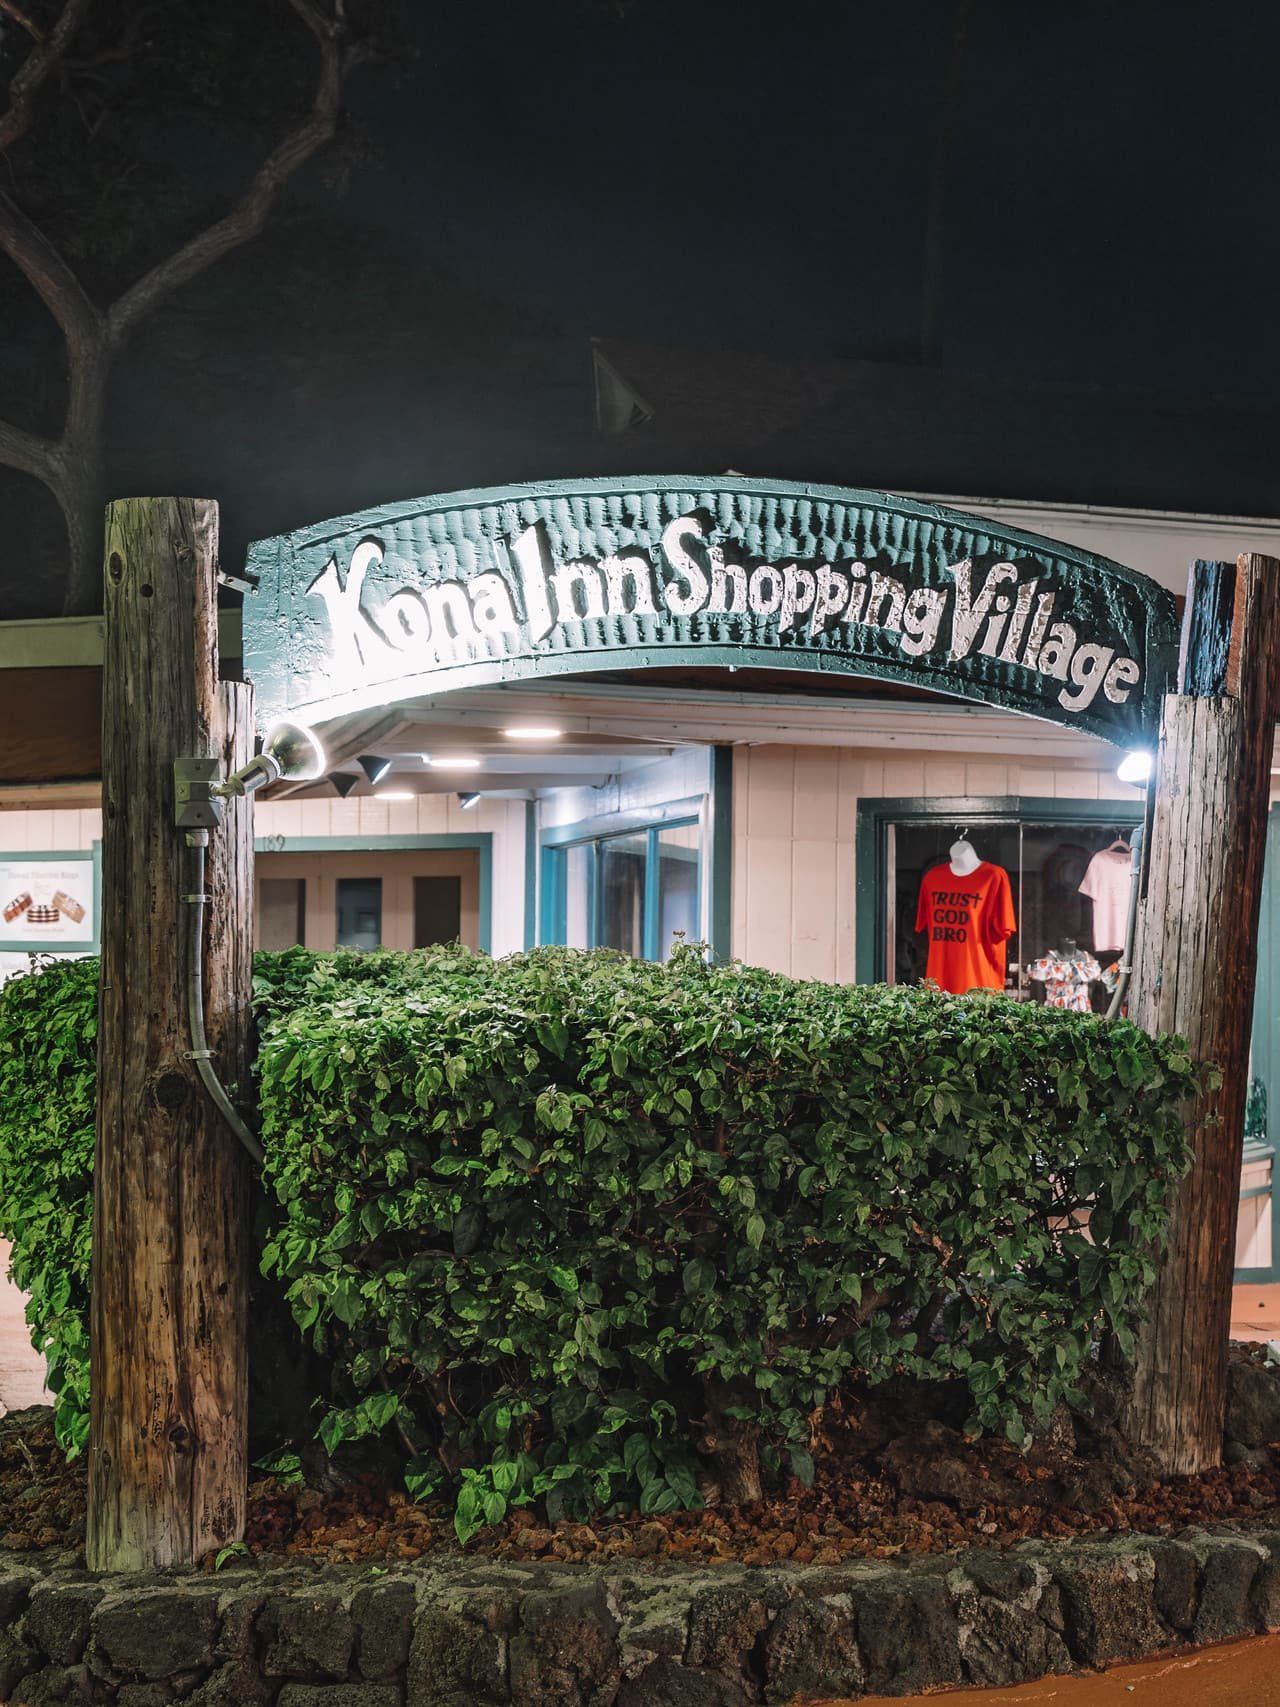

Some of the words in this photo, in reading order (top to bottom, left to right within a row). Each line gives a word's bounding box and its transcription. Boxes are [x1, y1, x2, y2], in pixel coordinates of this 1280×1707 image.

[305, 541, 523, 668] Kona
[510, 525, 656, 642] Inn
[663, 517, 948, 656] Shopping
[945, 558, 1140, 712] Village
[263, 834, 286, 851] 189
[931, 891, 983, 909] TRUST
[934, 909, 970, 925] GOD
[932, 926, 967, 943] BRO
